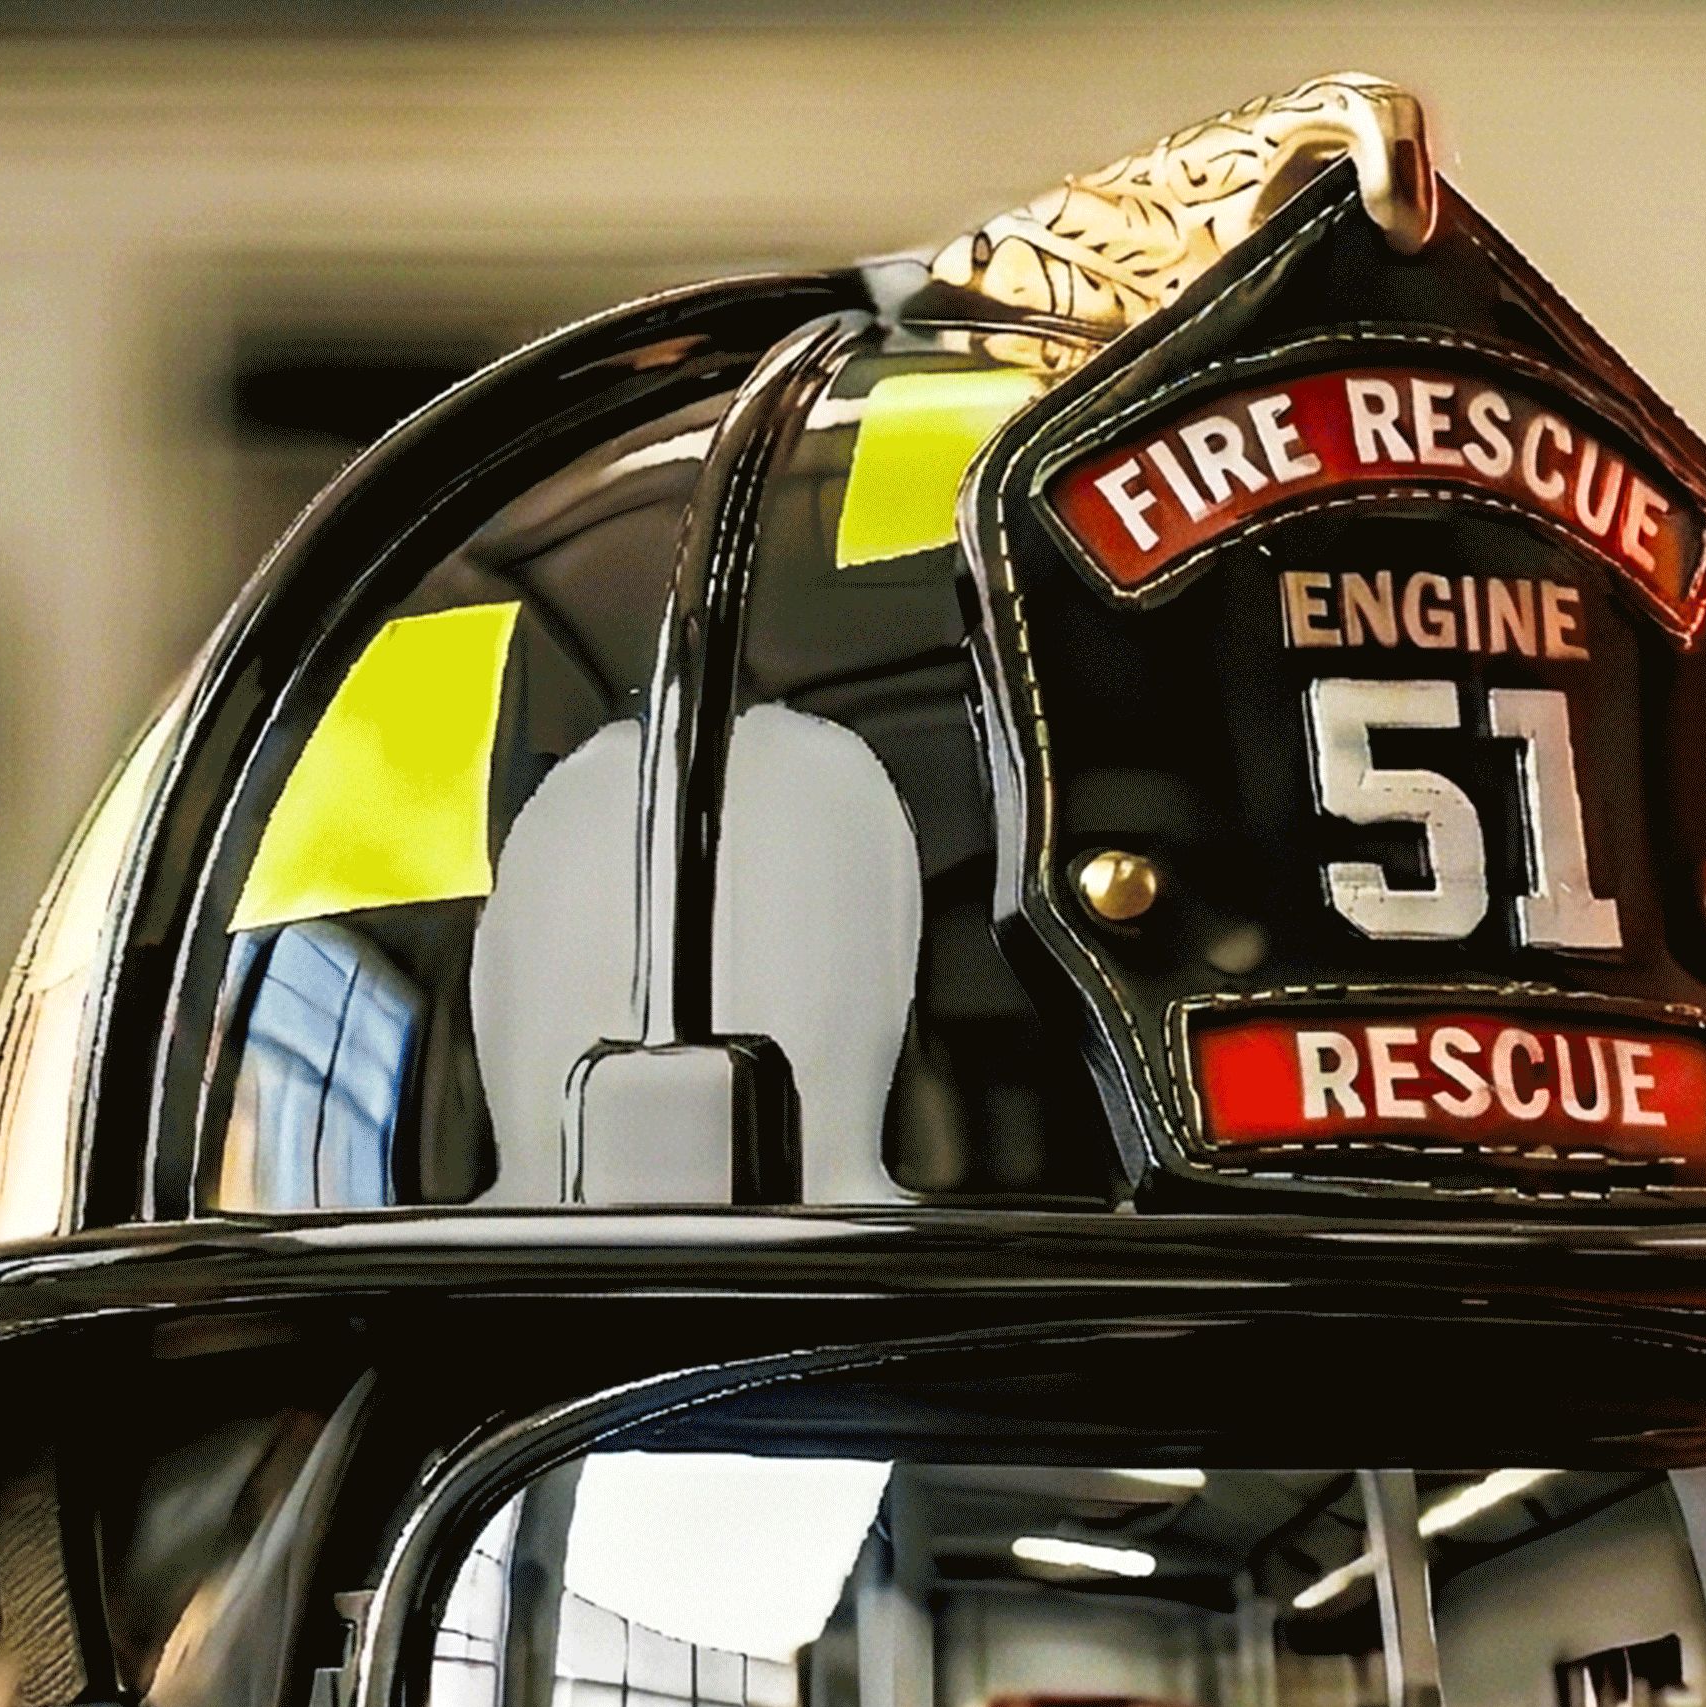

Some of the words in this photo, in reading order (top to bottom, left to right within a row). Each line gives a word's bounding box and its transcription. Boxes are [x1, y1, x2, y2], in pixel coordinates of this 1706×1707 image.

[1093, 393, 1321, 553] FIRE
[1344, 377, 1671, 571] RESCUE
[1279, 569, 1592, 662] ENGINE
[1307, 677, 1625, 952] 51
[1295, 1026, 1669, 1128] RESCUE
